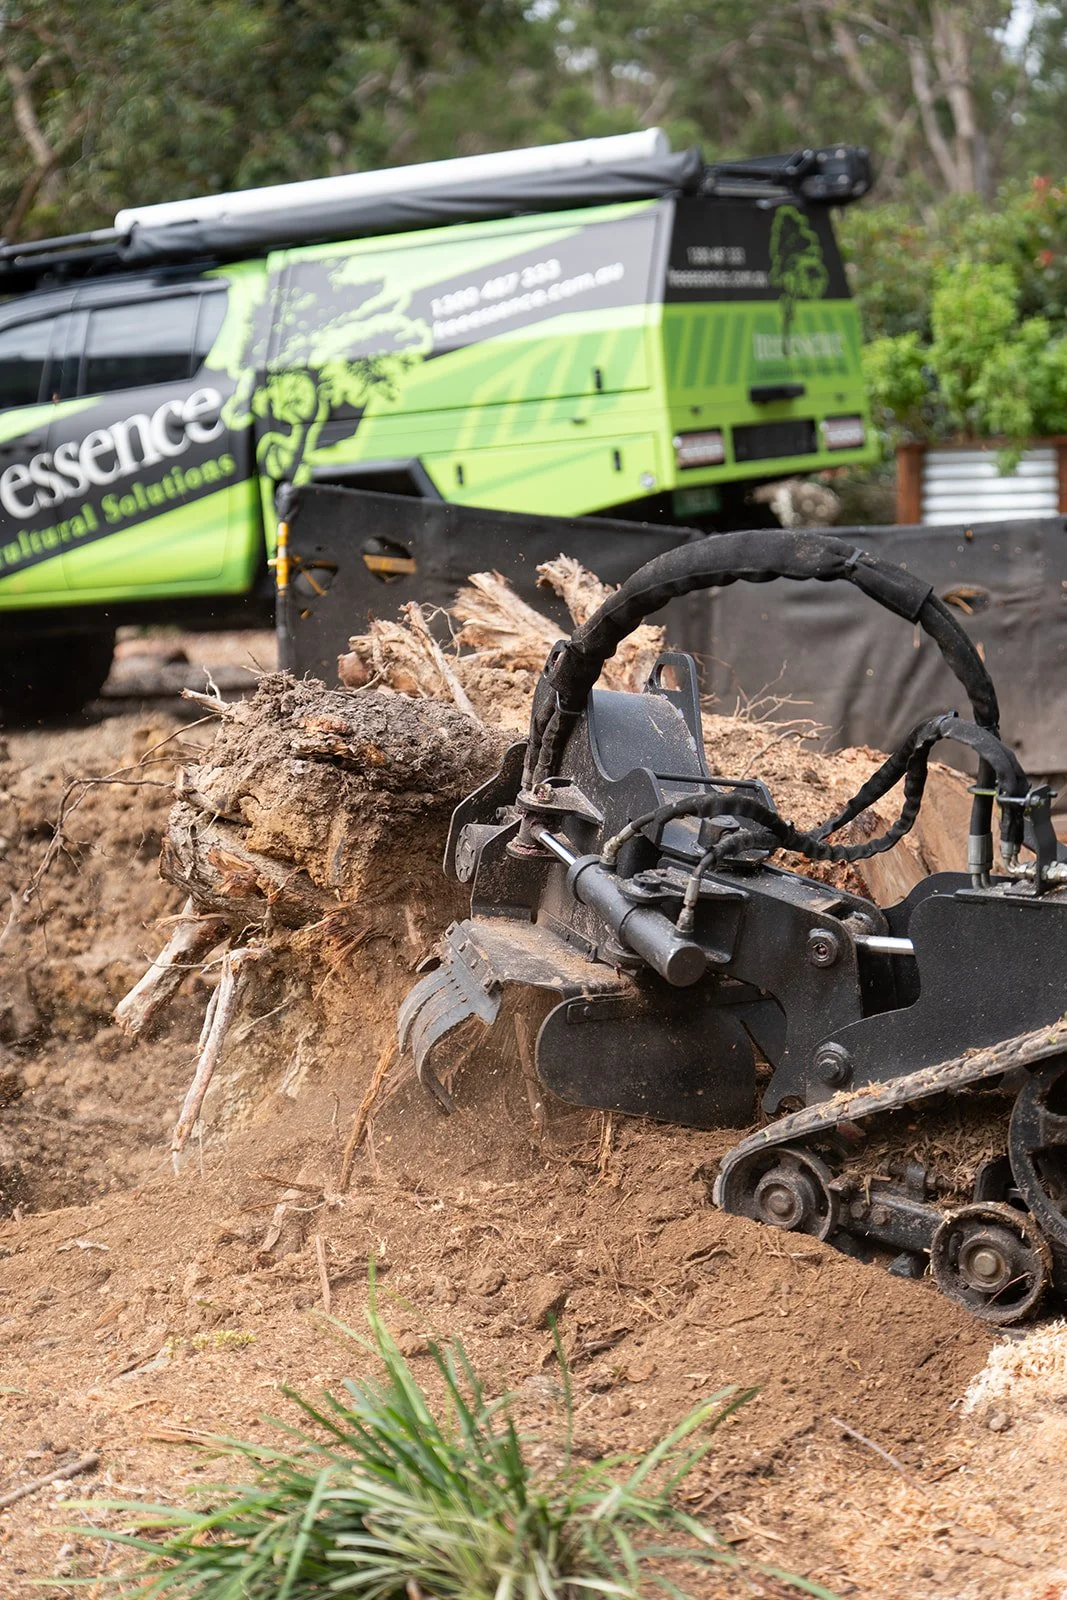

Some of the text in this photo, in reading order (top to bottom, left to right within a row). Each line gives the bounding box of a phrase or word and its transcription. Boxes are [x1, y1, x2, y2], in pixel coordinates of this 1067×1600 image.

[0, 453, 237, 570] ultural Solutions
[1, 387, 226, 519] essence
